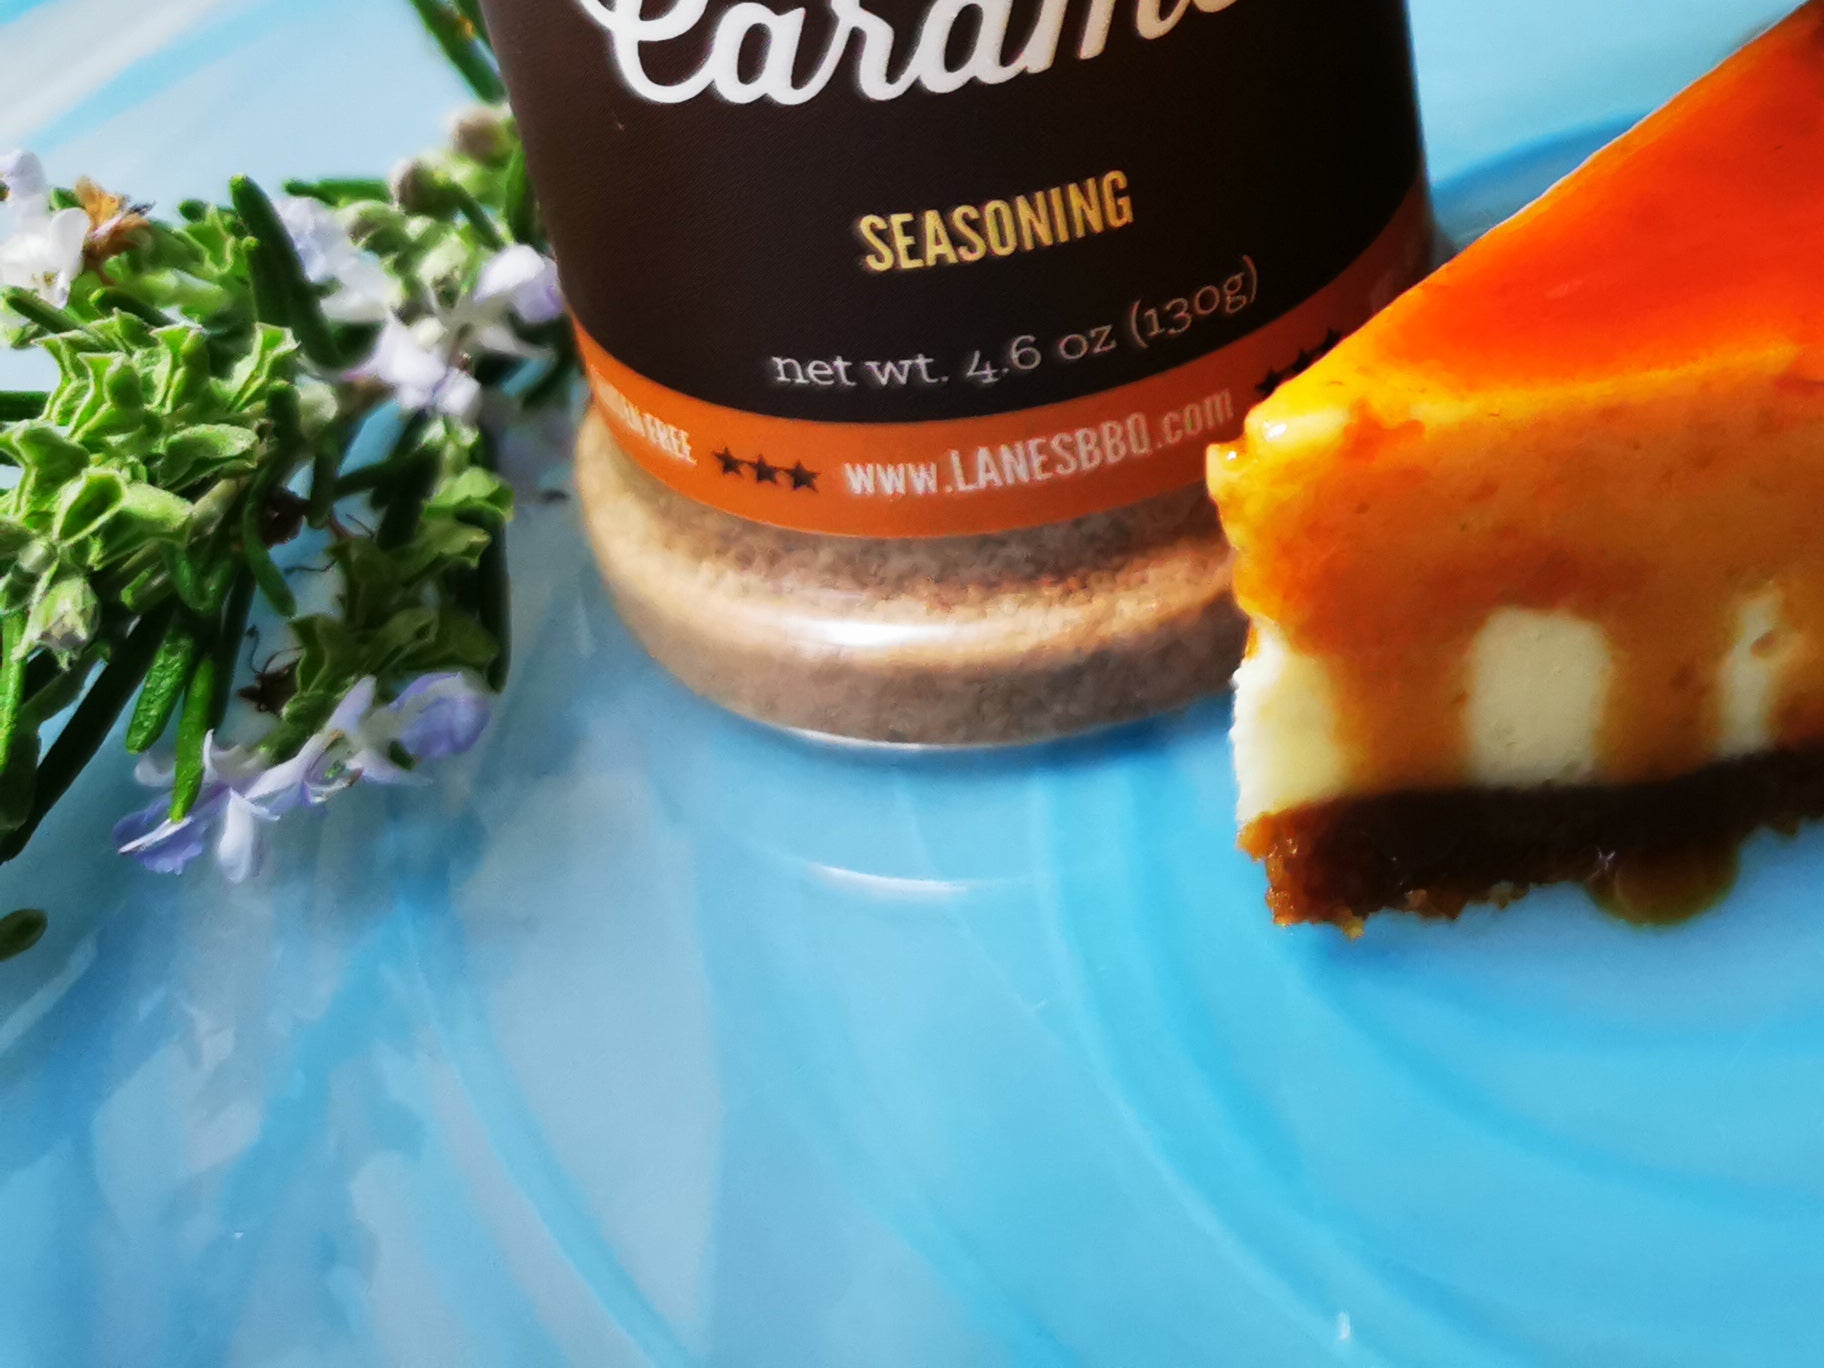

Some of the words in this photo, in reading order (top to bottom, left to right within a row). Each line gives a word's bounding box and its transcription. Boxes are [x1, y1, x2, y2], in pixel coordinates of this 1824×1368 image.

[858, 169, 1135, 273] SEASONING
[771, 352, 857, 387] net
[863, 352, 949, 387] wt.
[965, 334, 1042, 385] 4.6
[1058, 323, 1118, 360] oz
[1129, 254, 1258, 348] (130g)
[843, 388, 1235, 497] www.LANESBBQ.com
